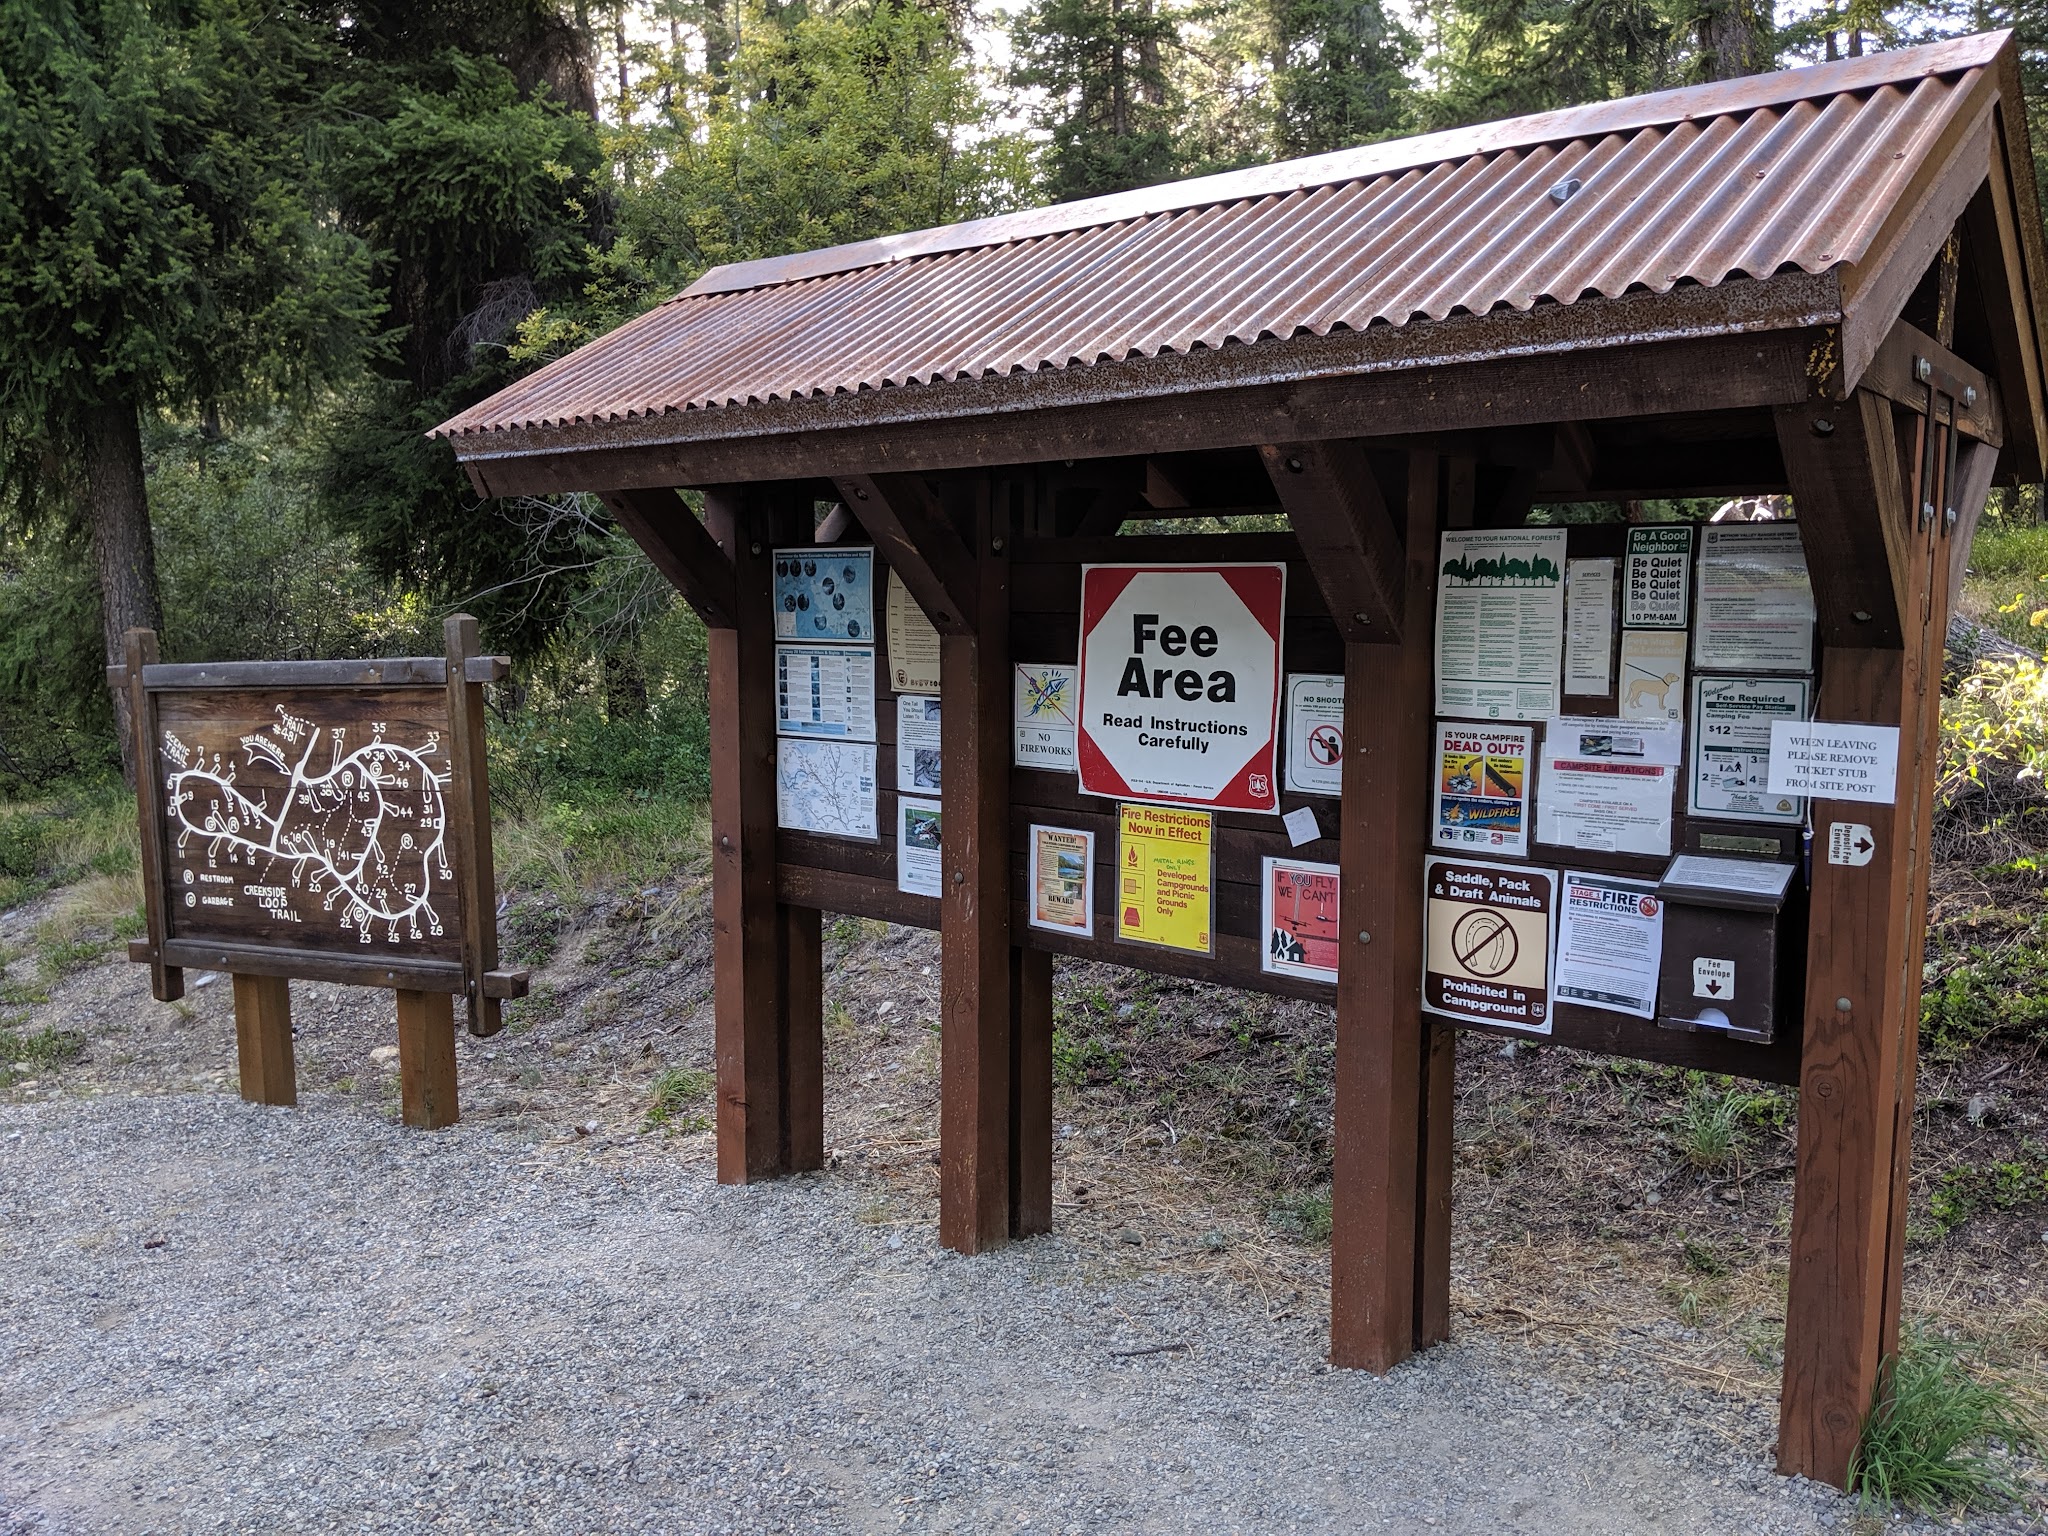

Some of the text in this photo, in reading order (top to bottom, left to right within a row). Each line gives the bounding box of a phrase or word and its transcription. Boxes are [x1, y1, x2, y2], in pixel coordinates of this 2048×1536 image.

[1634, 531, 1687, 541] Be A Good
[1632, 542, 1678, 553] Neighbor
[1632, 557, 1682, 568] Be Quiet
[1632, 568, 1681, 579] Be Quiet
[1631, 580, 1680, 590] Be Quiet
[1631, 590, 1680, 601] Be Quiet
[1630, 601, 1680, 612] Be Quiet
[1631, 613, 1676, 621] 10 PM-6AM
[1133, 614, 1219, 657] Fee
[1117, 657, 1236, 703] Area
[1703, 682, 1734, 697] Welcome!
[1739, 694, 1785, 703] Required
[282, 715, 306, 736] TRAIL
[372, 722, 386, 732] 35
[1103, 713, 1248, 736] Read Instructions
[272, 724, 298, 745] #481
[332, 728, 346, 739] 37
[1709, 725, 1730, 735] $12
[240, 735, 254, 744] YOU
[427, 732, 440, 742] 33
[1038, 733, 1050, 742] NO
[1454, 732, 1478, 740] YOUR
[1480, 734, 1525, 742] CAMPFIRE
[164, 730, 190, 756] SCENIC
[1138, 733, 1209, 754] Carefully
[1444, 740, 1524, 755] DEAD OUT?
[1789, 737, 1877, 750] WHEN LEAVING
[166, 740, 187, 766] TRAIL
[1020, 744, 1072, 755] FIREWORKS
[373, 751, 385, 761] 36
[1787, 751, 1878, 765] PLEASE REMOVE
[398, 762, 410, 771] 34
[1560, 762, 1657, 775] CAMPSITE LIMITATIONS
[1795, 765, 1868, 778] TICKET STUB
[1702, 773, 1709, 781] 2
[396, 777, 409, 788] 46
[1786, 779, 1876, 794] FROM SITE POST
[299, 794, 310, 804] 39
[357, 792, 370, 802] 45
[211, 800, 219, 810] 13
[423, 804, 433, 814] 31
[168, 806, 176, 816] 10
[400, 808, 413, 817] 44
[1469, 807, 1520, 819] WILDFIRE!
[420, 818, 432, 828] 29
[1122, 808, 1210, 828] Fire Restrictions
[361, 828, 372, 838] 43
[1128, 822, 1202, 841] Now in Effect
[280, 835, 288, 845] 16
[292, 833, 301, 843] 18
[1048, 834, 1076, 844] WANTED!
[326, 839, 335, 848] 19
[1832, 828, 1843, 859] Envelope
[1842, 825, 1852, 864] Deposit Fee
[230, 854, 238, 863] 14
[247, 856, 255, 865] 15
[340, 851, 349, 860] 41
[209, 859, 217, 868] 12
[376, 864, 388, 874] 42
[200, 874, 234, 884] RESTROOM
[440, 870, 452, 880] 30
[1157, 869, 1197, 881] Developed
[1277, 871, 1285, 883] IF
[1288, 872, 1312, 887] YOU
[292, 879, 300, 888] 17
[1157, 879, 1208, 892] Campgrounds
[1445, 871, 1531, 892] Saddle, Pack
[244, 885, 286, 898] CREEKSIDE
[309, 884, 321, 893] 20
[355, 884, 368, 894] 40
[404, 884, 416, 893] 27
[376, 889, 387, 899] 24
[1157, 888, 1195, 900] and Picnic
[1278, 886, 1336, 903] WE CAN'T
[1435, 884, 1542, 908] & Draft Animals
[1571, 889, 1594, 897] STAGE
[1602, 891, 1639, 906] FIRE
[202, 896, 234, 906] GARBAGE
[259, 897, 288, 908] LOOP
[1048, 895, 1074, 905] REWARD
[1157, 897, 1187, 908] Grounds
[324, 901, 333, 911] 21
[1569, 898, 1638, 914] RESTRICTIONS
[269, 909, 302, 922] TRAIL
[1157, 906, 1173, 917] Only
[340, 919, 352, 928] 22
[410, 928, 422, 939] 26
[430, 926, 443, 936] 28
[360, 934, 371, 944] 23
[388, 933, 399, 943] 25
[1708, 960, 1720, 968] Fee
[1698, 968, 1731, 978] Envelope
[1442, 978, 1526, 1001] Prohibited in
[1442, 993, 1526, 1015] Campground
